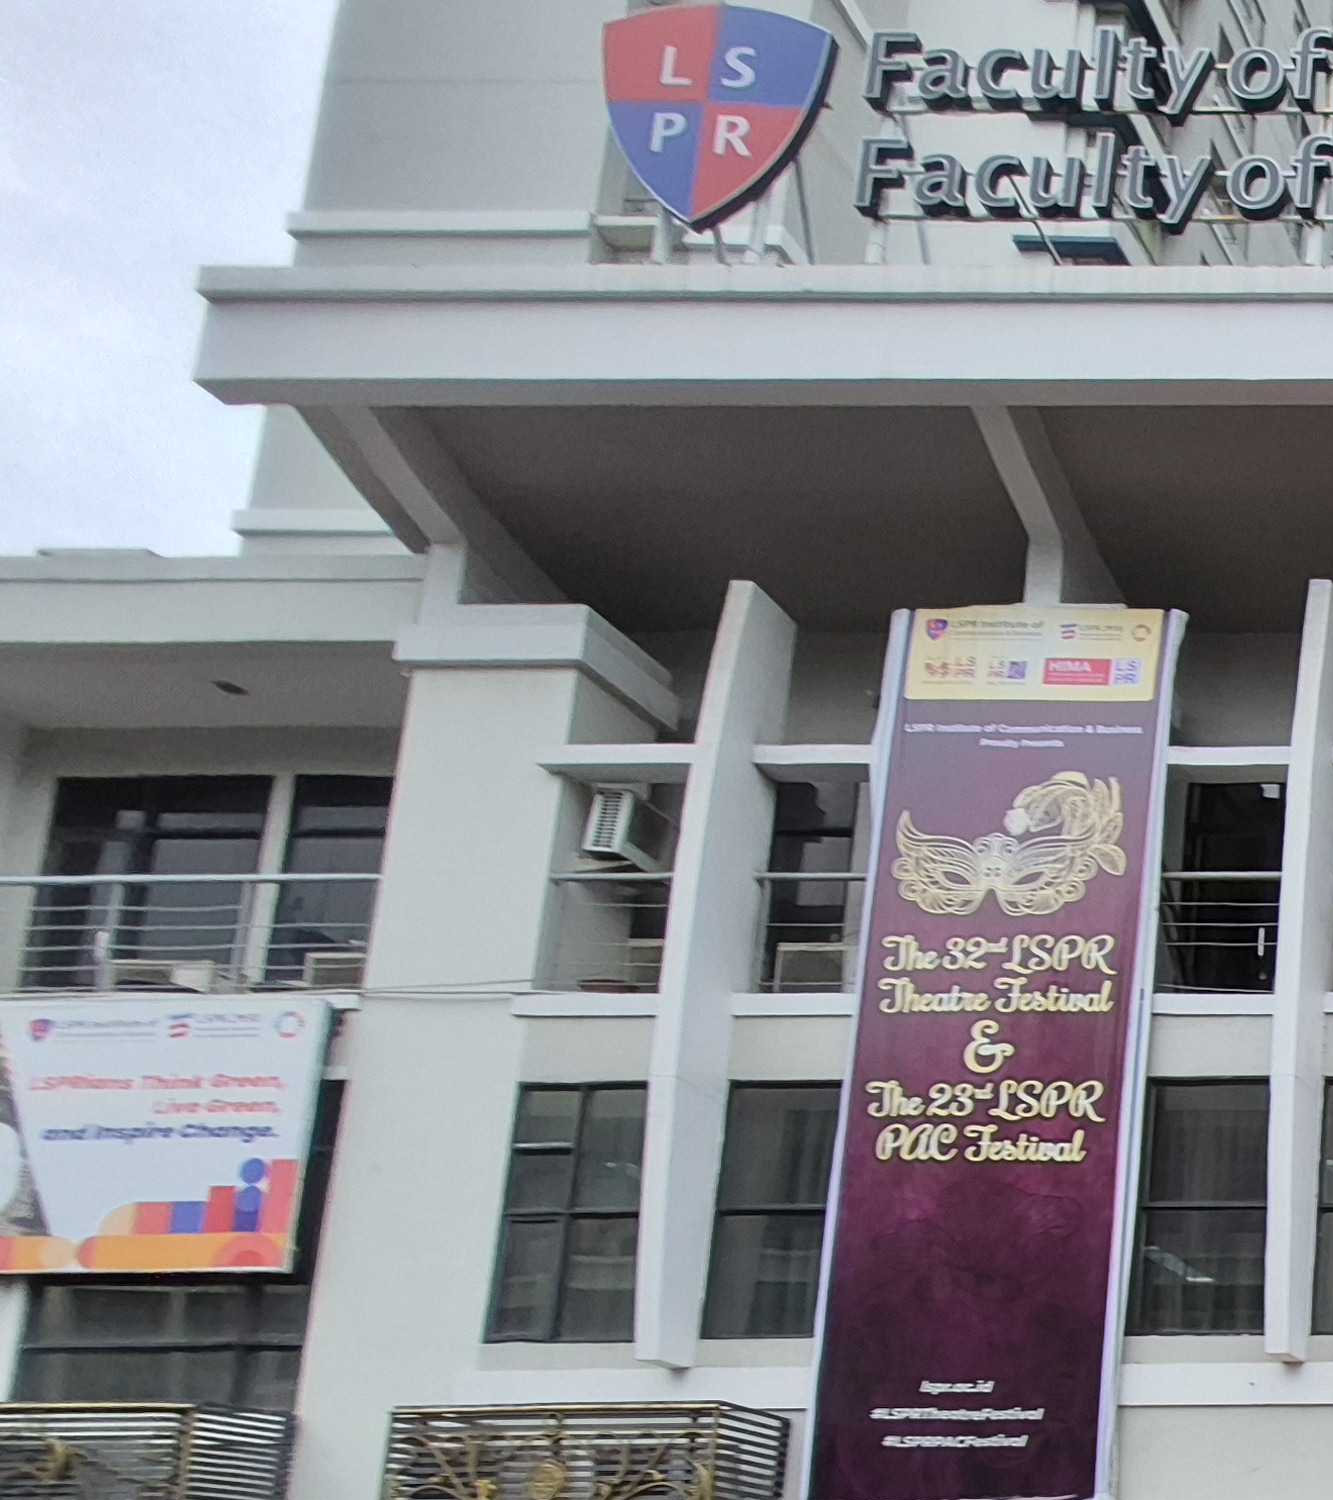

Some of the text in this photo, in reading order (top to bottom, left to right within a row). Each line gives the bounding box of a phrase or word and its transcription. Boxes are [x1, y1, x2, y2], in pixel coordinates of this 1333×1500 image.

[657, 45, 758, 89] L S
[863, 28, 1212, 121] Faculty
[648, 112, 751, 159] P R
[852, 133, 1212, 229] Faculty
[882, 935, 942, 971] The
[1001, 934, 1118, 975] LSPR
[877, 977, 1115, 1013] Theatre Festival
[963, 1019, 1015, 1073] &
[865, 1080, 927, 1117] The
[988, 1080, 1106, 1122] LSPR
[875, 1123, 1087, 1162] PAC Festival
